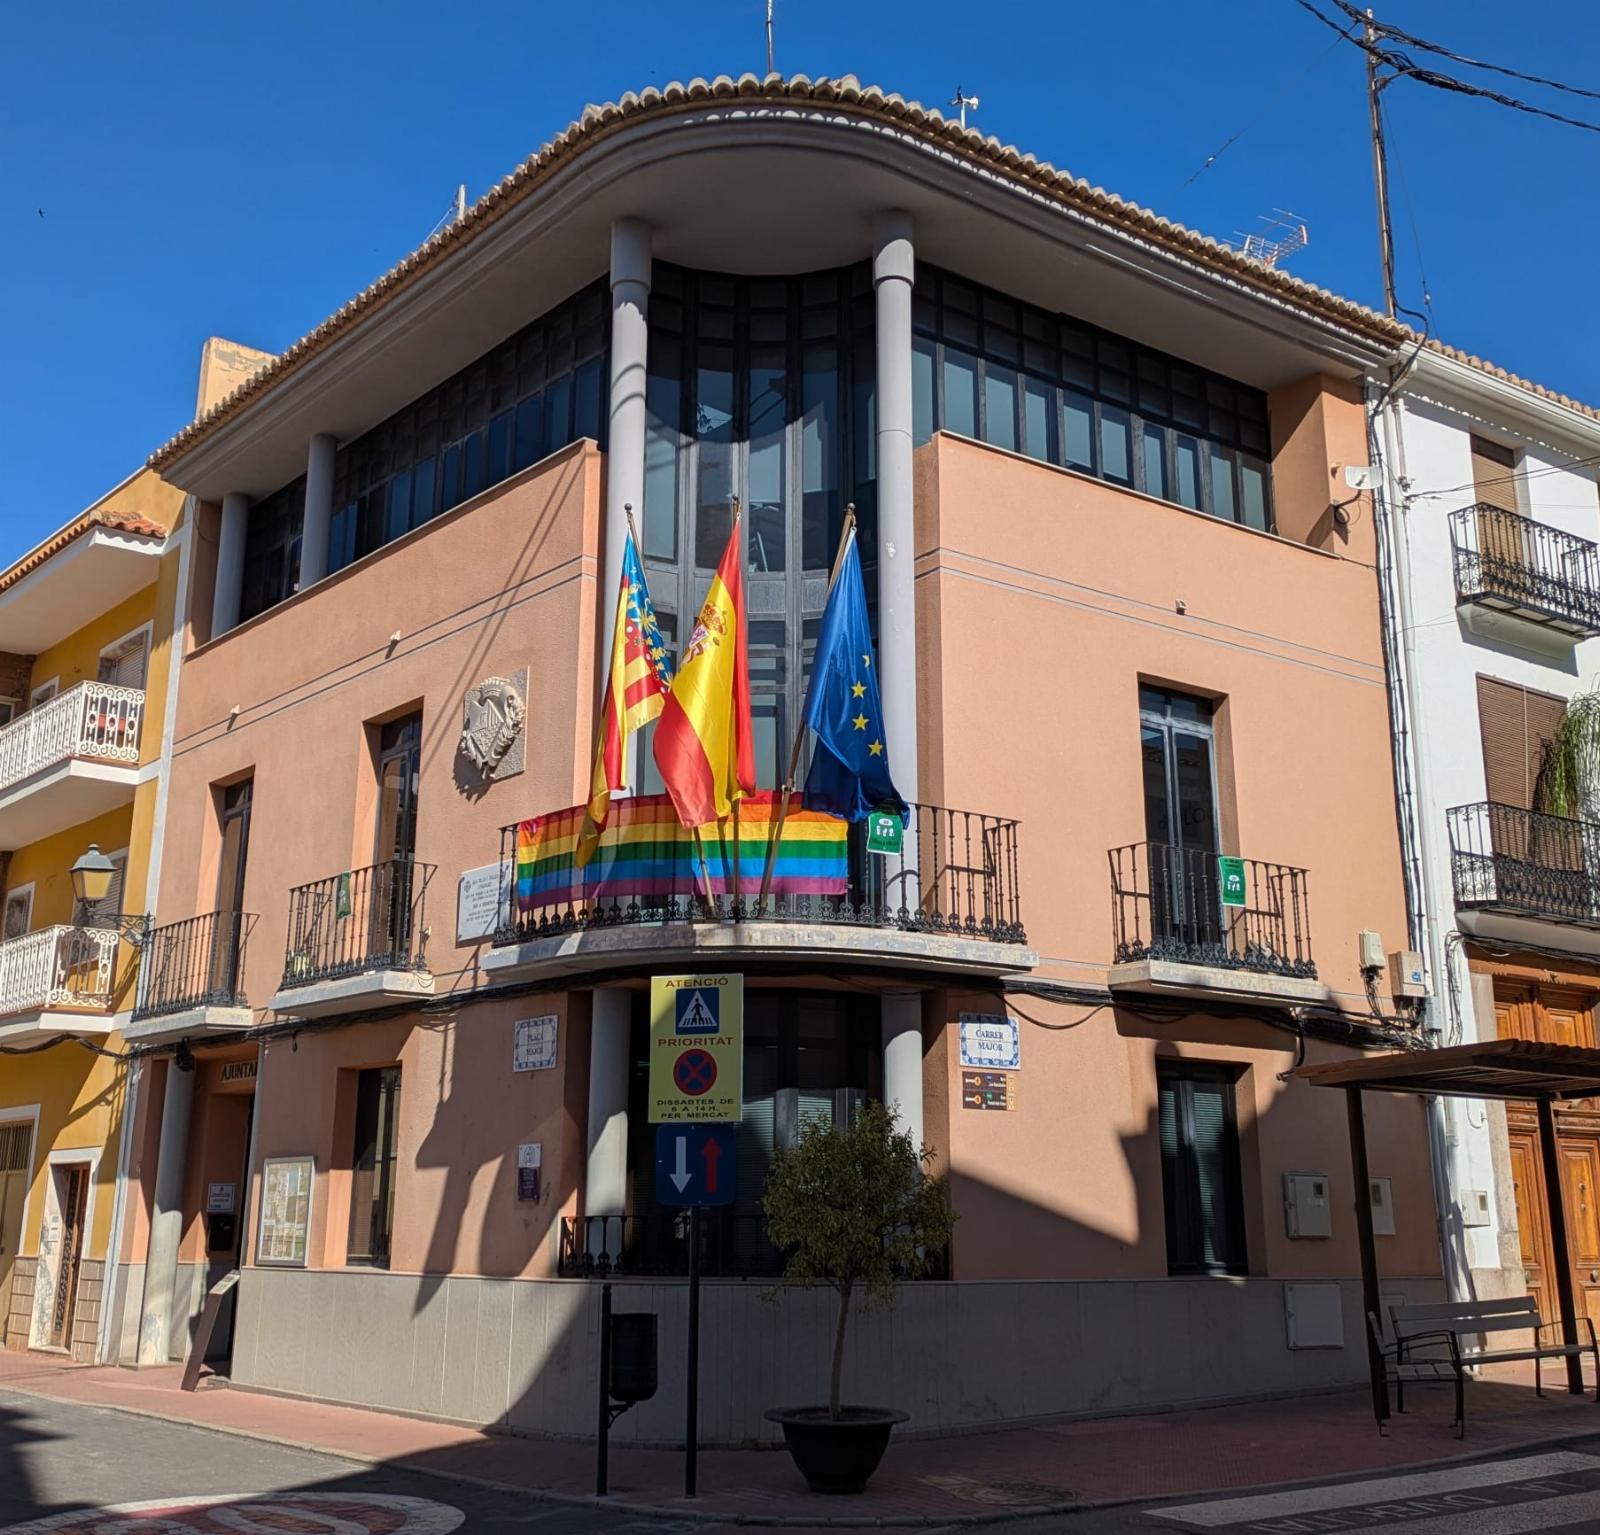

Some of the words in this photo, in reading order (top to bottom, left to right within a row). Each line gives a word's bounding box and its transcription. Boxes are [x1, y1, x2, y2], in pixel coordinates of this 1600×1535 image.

[665, 976, 729, 988] ATENCIÓ
[975, 1029, 1004, 1039] CARRER
[657, 1036, 734, 1047] PRIORITAT
[978, 1042, 1004, 1051] MAJOR
[686, 1111, 730, 1119] MERCAT
